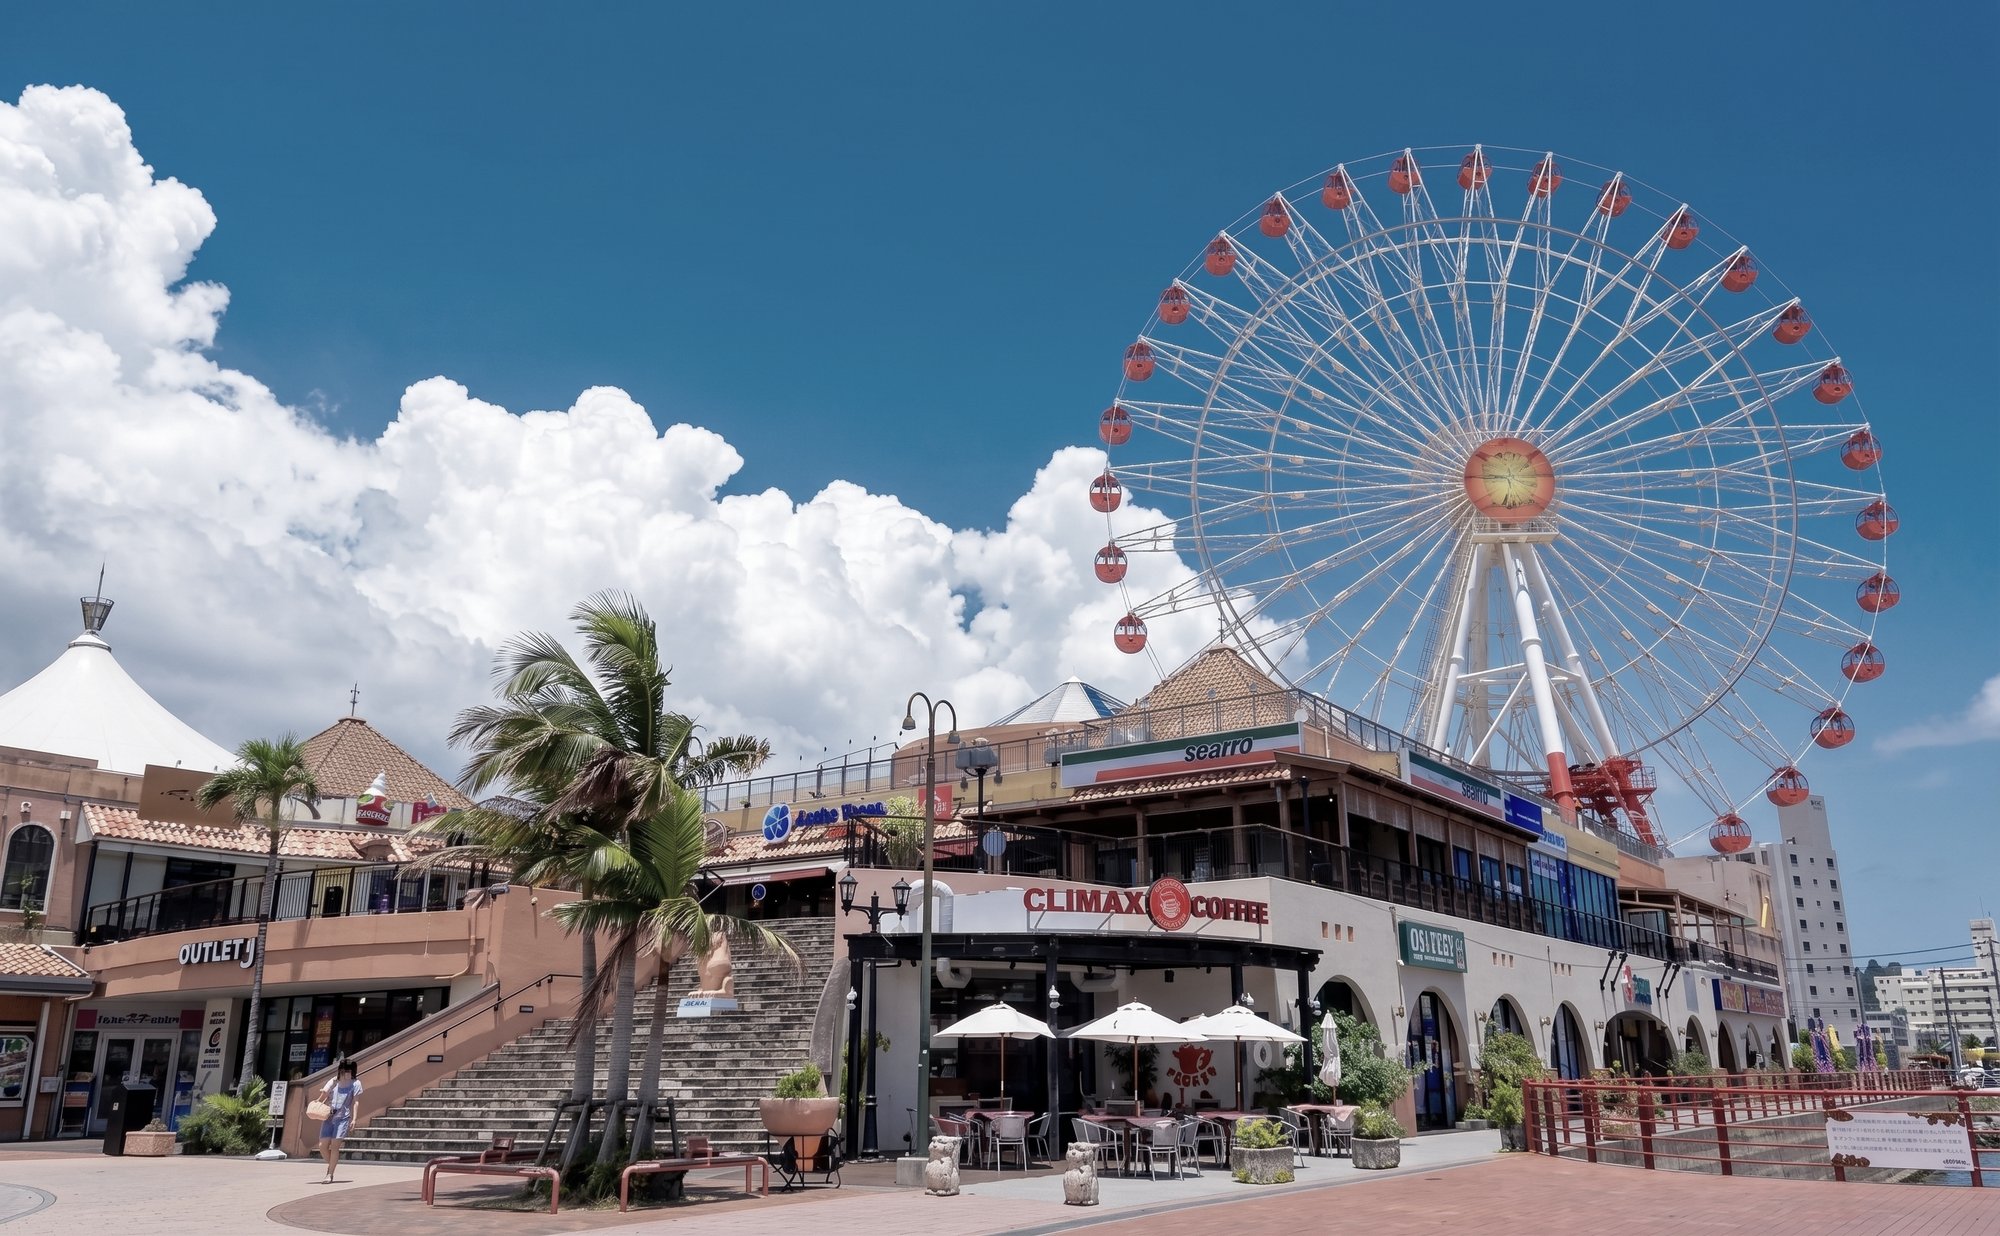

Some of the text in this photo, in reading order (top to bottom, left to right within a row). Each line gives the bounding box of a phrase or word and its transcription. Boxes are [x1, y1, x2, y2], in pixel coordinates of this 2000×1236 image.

[1184, 736, 1254, 762] searro
[1023, 887, 1147, 915] CLIMAX
[1190, 896, 1270, 925] COFFEE
[179, 938, 245, 966] OUTLET
